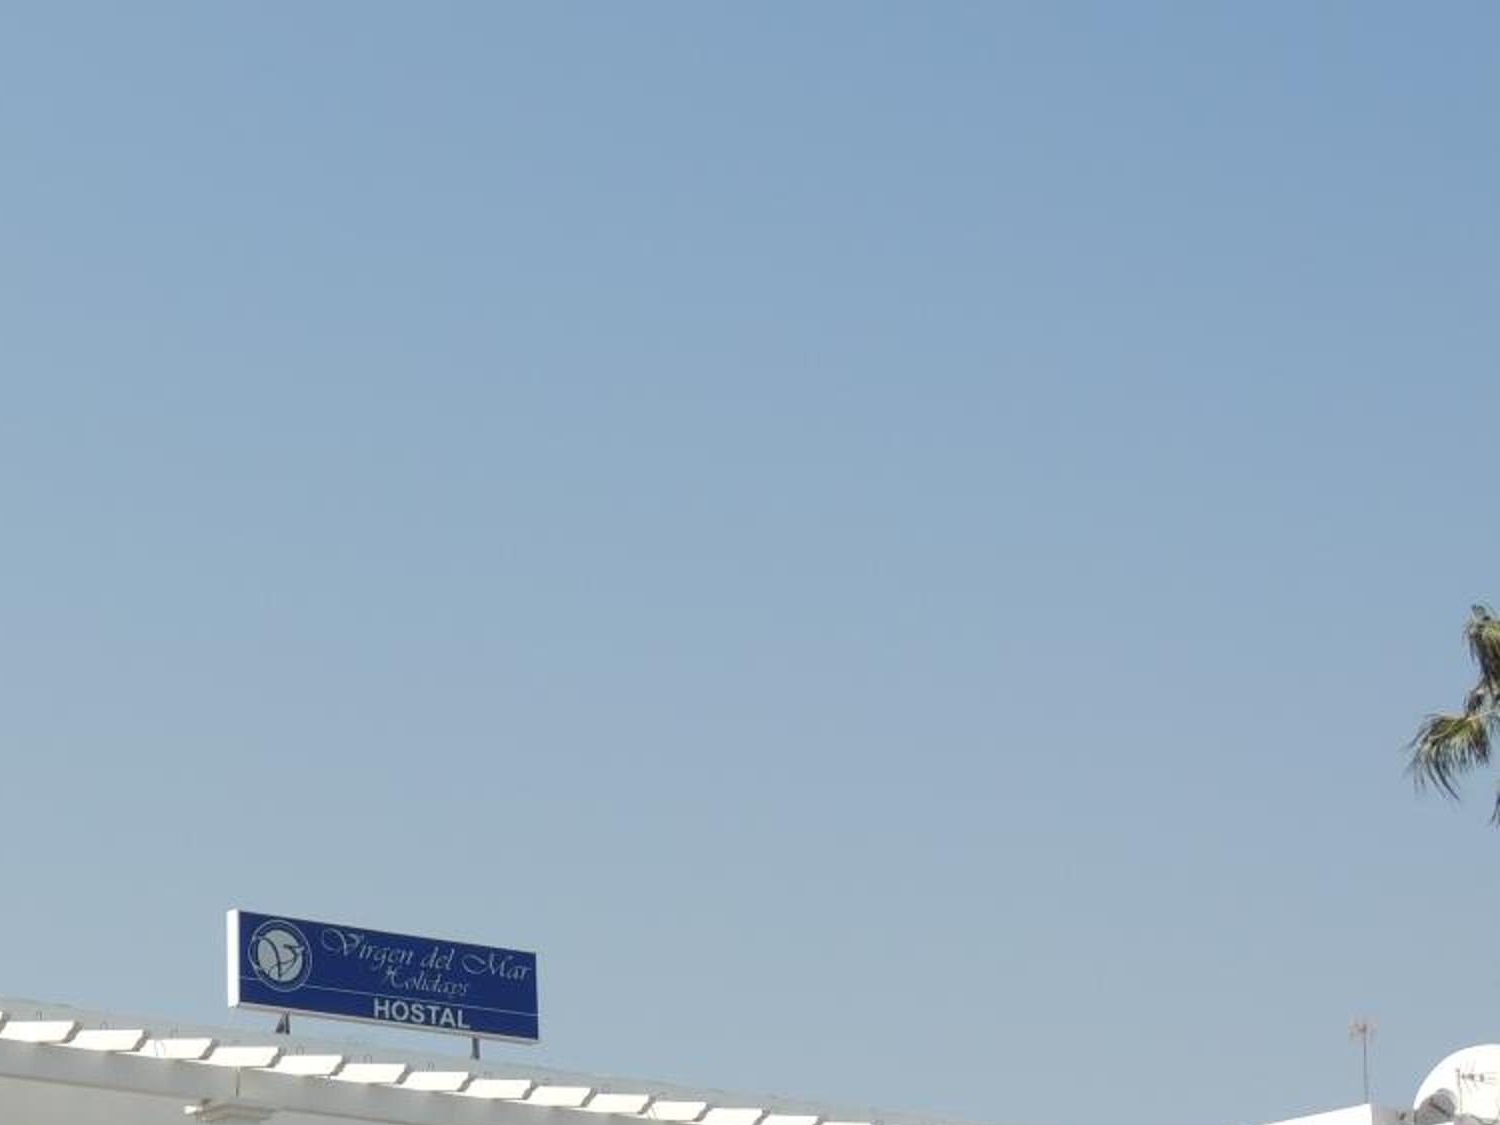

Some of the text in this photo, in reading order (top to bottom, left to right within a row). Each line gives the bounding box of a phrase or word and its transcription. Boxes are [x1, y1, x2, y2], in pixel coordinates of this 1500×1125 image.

[320, 928, 531, 982] Virgen del Mar
[382, 965, 469, 998] Holidays
[373, 997, 470, 1029] HOSTAL
